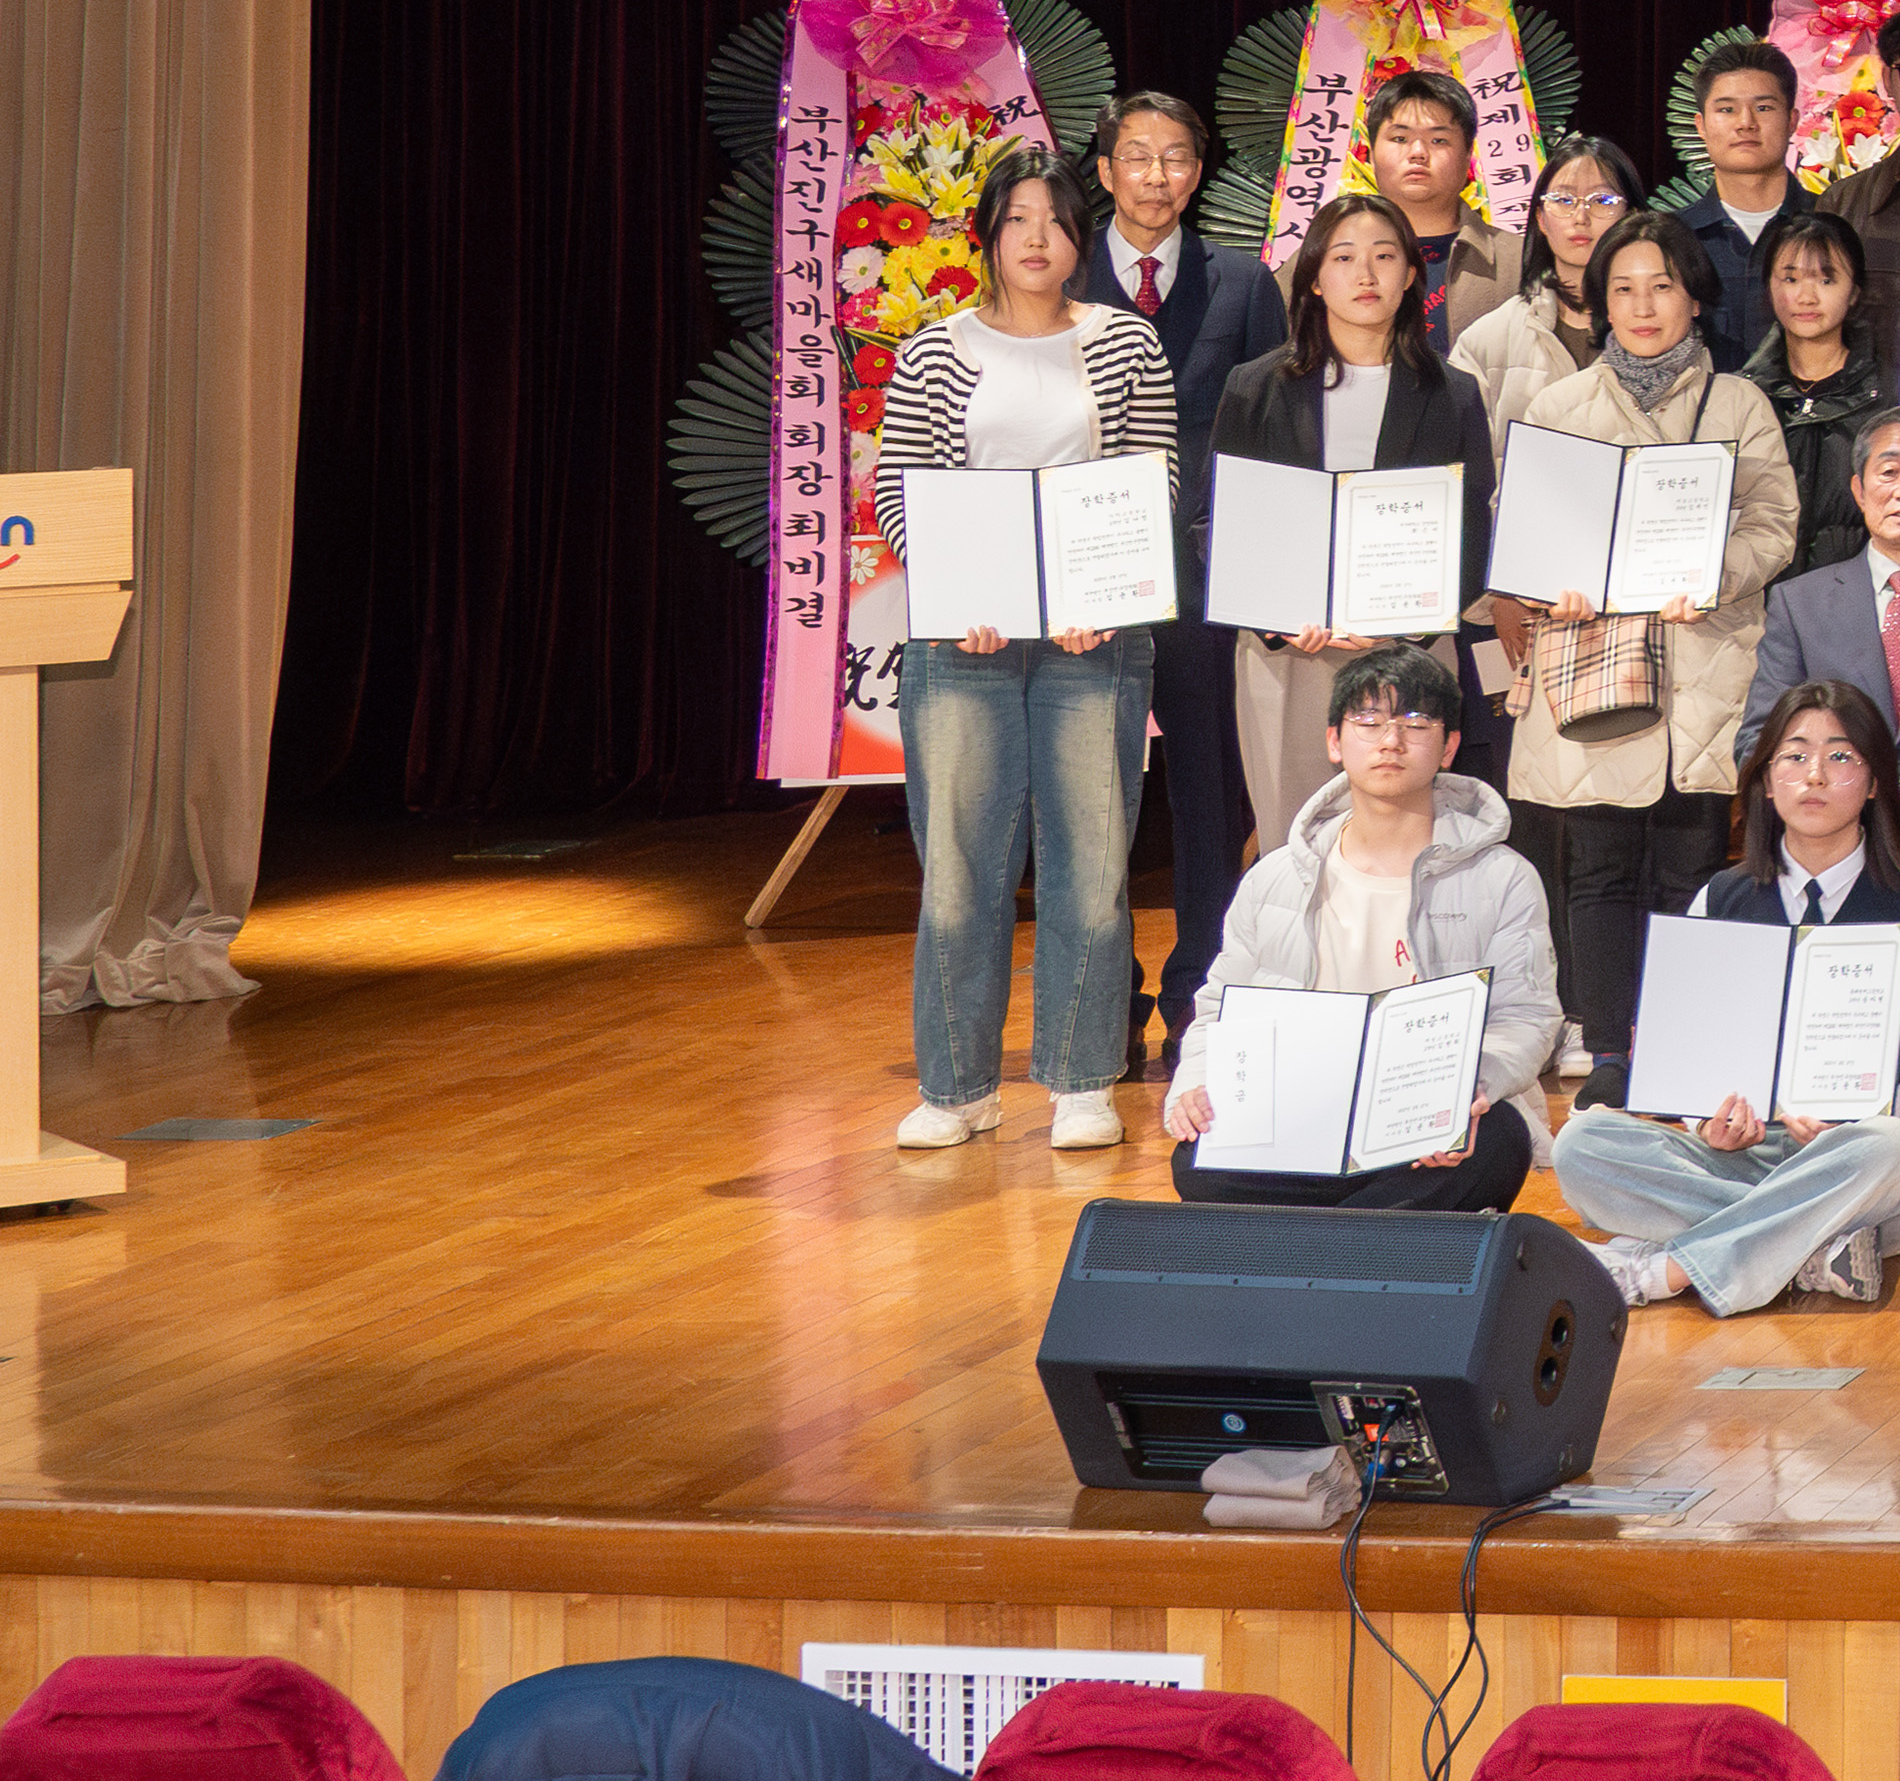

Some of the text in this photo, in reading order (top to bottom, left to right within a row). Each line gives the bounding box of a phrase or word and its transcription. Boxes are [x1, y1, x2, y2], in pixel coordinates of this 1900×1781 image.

[1472, 71, 1525, 100] 祝
[782, 104, 844, 631] 부산진구새마을회 회장 최비결
